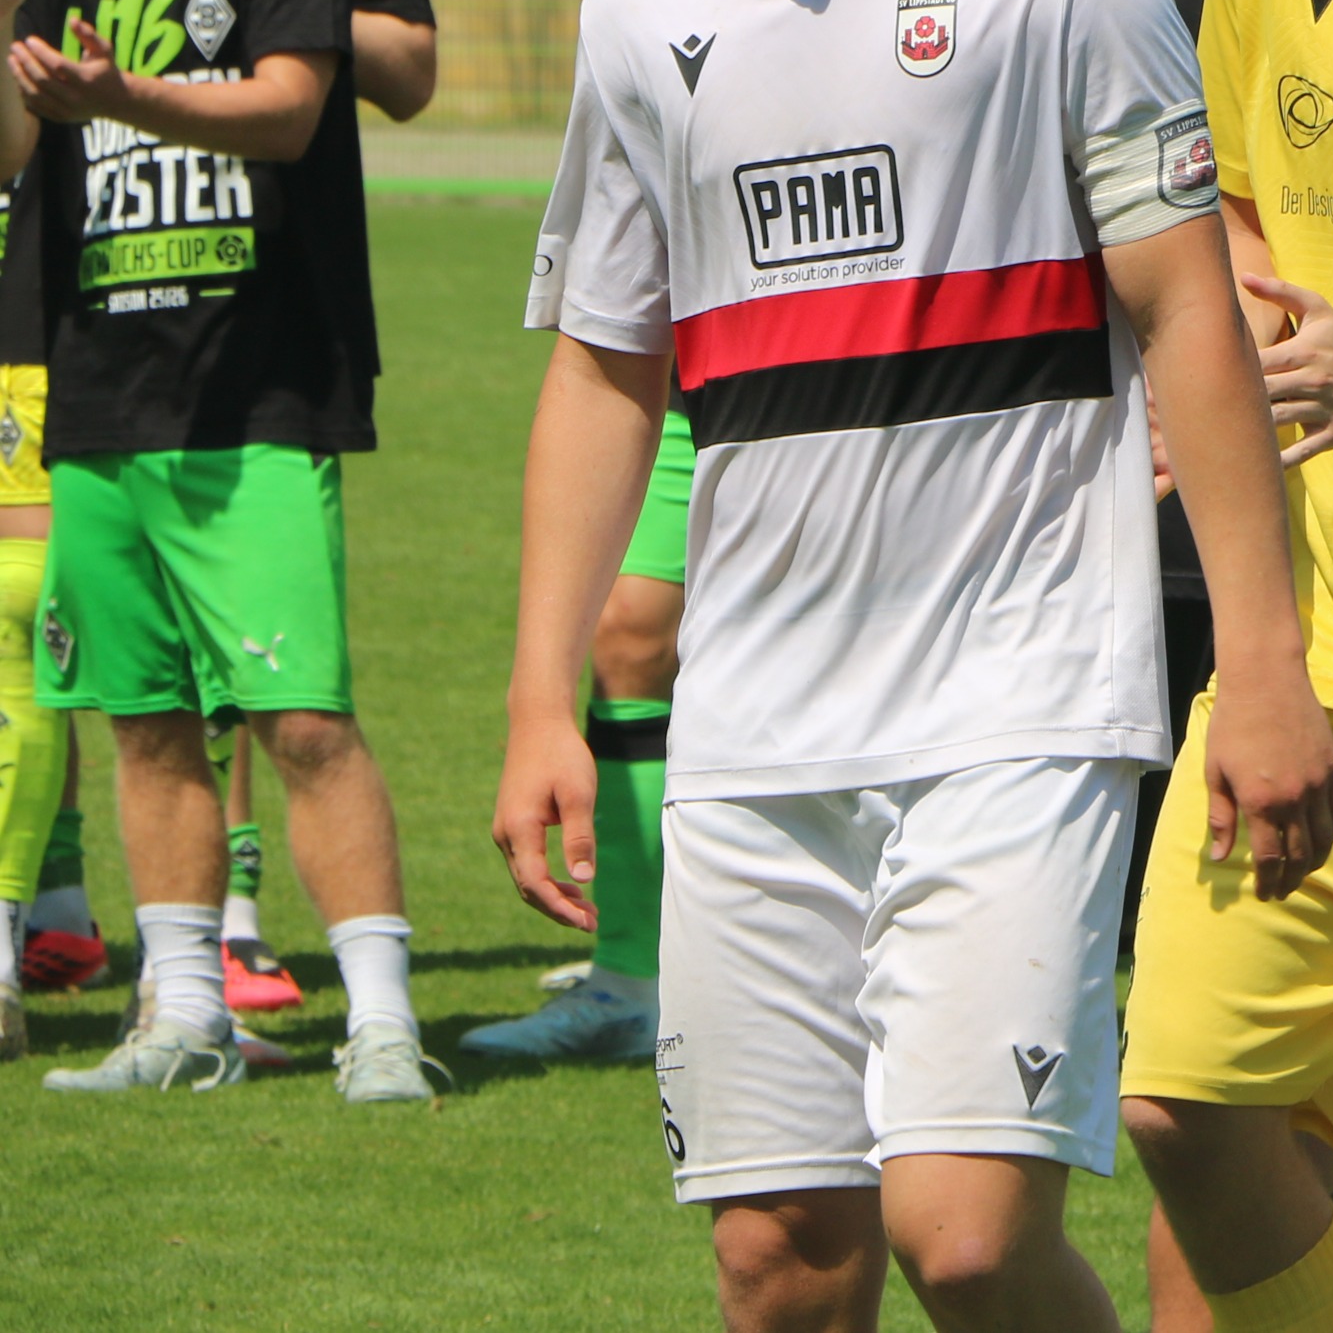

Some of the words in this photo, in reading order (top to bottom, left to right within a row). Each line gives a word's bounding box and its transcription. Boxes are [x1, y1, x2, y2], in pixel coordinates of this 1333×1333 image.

[1160, 127, 1174, 141] SV
[751, 166, 884, 250] PAMA
[1280, 185, 1304, 215] Der
[751, 274, 779, 292] your
[781, 265, 839, 285] solution
[843, 256, 906, 281] provider
